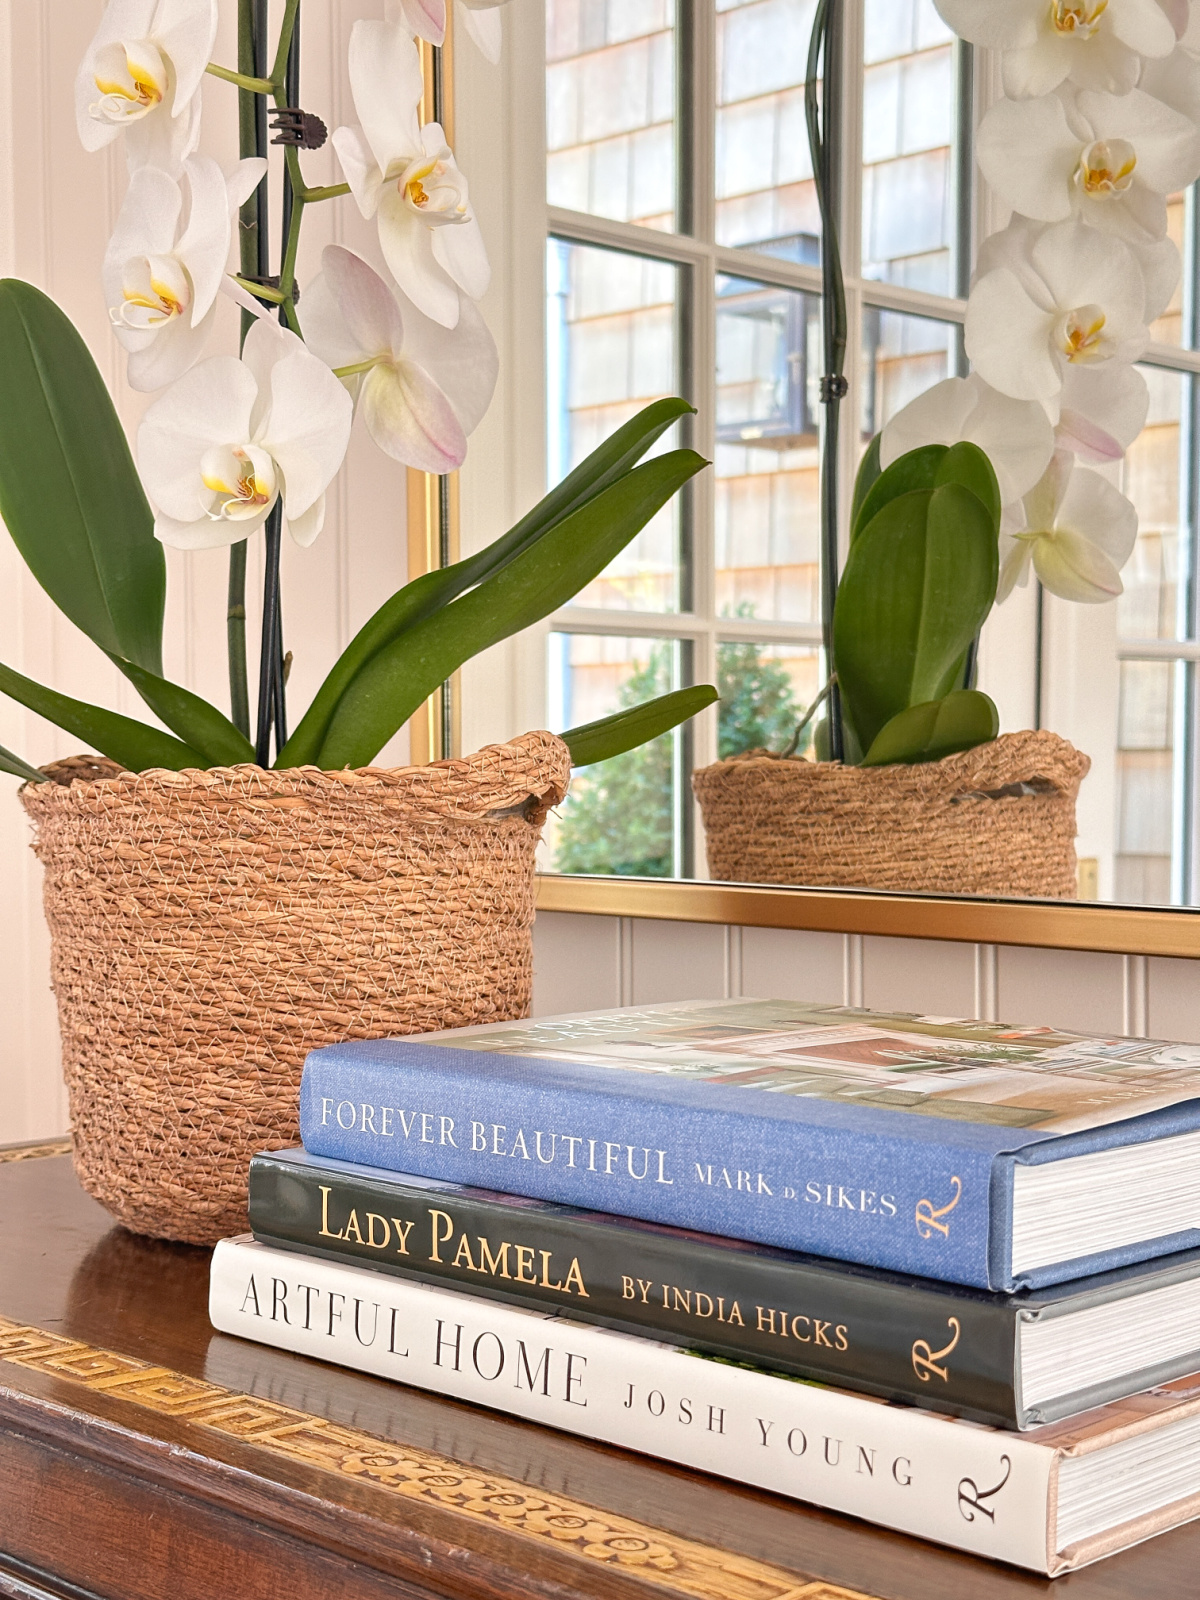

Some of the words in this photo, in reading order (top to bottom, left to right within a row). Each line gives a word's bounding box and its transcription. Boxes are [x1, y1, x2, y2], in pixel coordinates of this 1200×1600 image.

[320, 1098, 459, 1149] FOREVER
[470, 1121, 674, 1185] BEAUTIFUL
[694, 1163, 774, 1196] MARK
[805, 1181, 897, 1217] SIKES
[318, 1185, 416, 1256] LADY
[427, 1209, 590, 1298] PAMELA
[621, 1276, 653, 1303] BY
[662, 1284, 746, 1327] INDIA
[756, 1306, 849, 1352] HICKS
[239, 1273, 410, 1358] ARTFUL
[432, 1318, 590, 1408] HOME
[623, 1383, 728, 1435] JOSH
[756, 1418, 915, 1487] YOUNG
